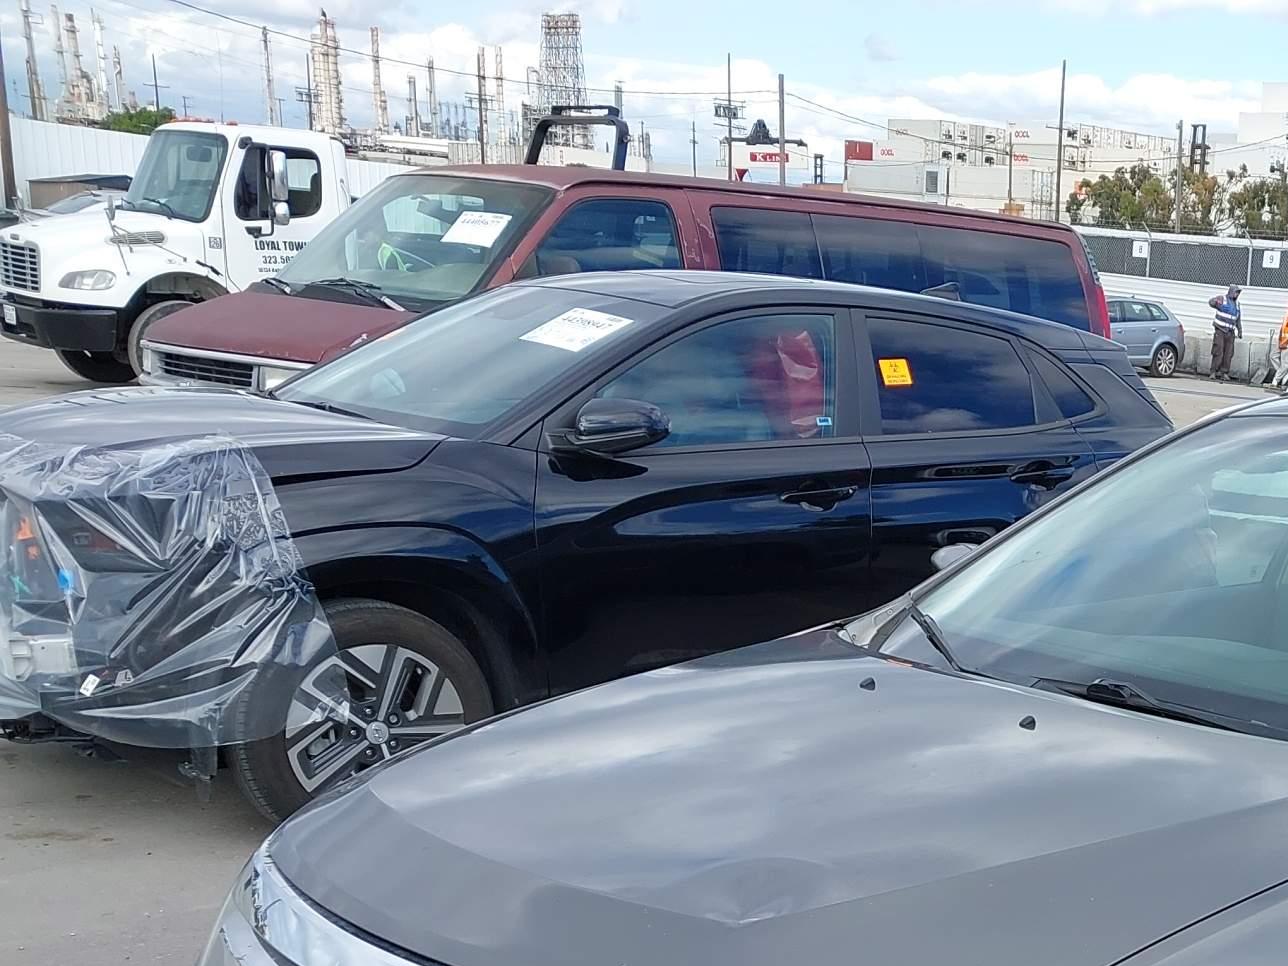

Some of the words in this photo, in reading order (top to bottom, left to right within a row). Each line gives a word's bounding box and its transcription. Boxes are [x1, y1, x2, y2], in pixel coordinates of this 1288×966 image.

[1014, 130, 1030, 138] OOCL
[879, 149, 895, 157] OOCL
[255, 240, 281, 251] LOYAL
[1269, 255, 1275, 264] 9
